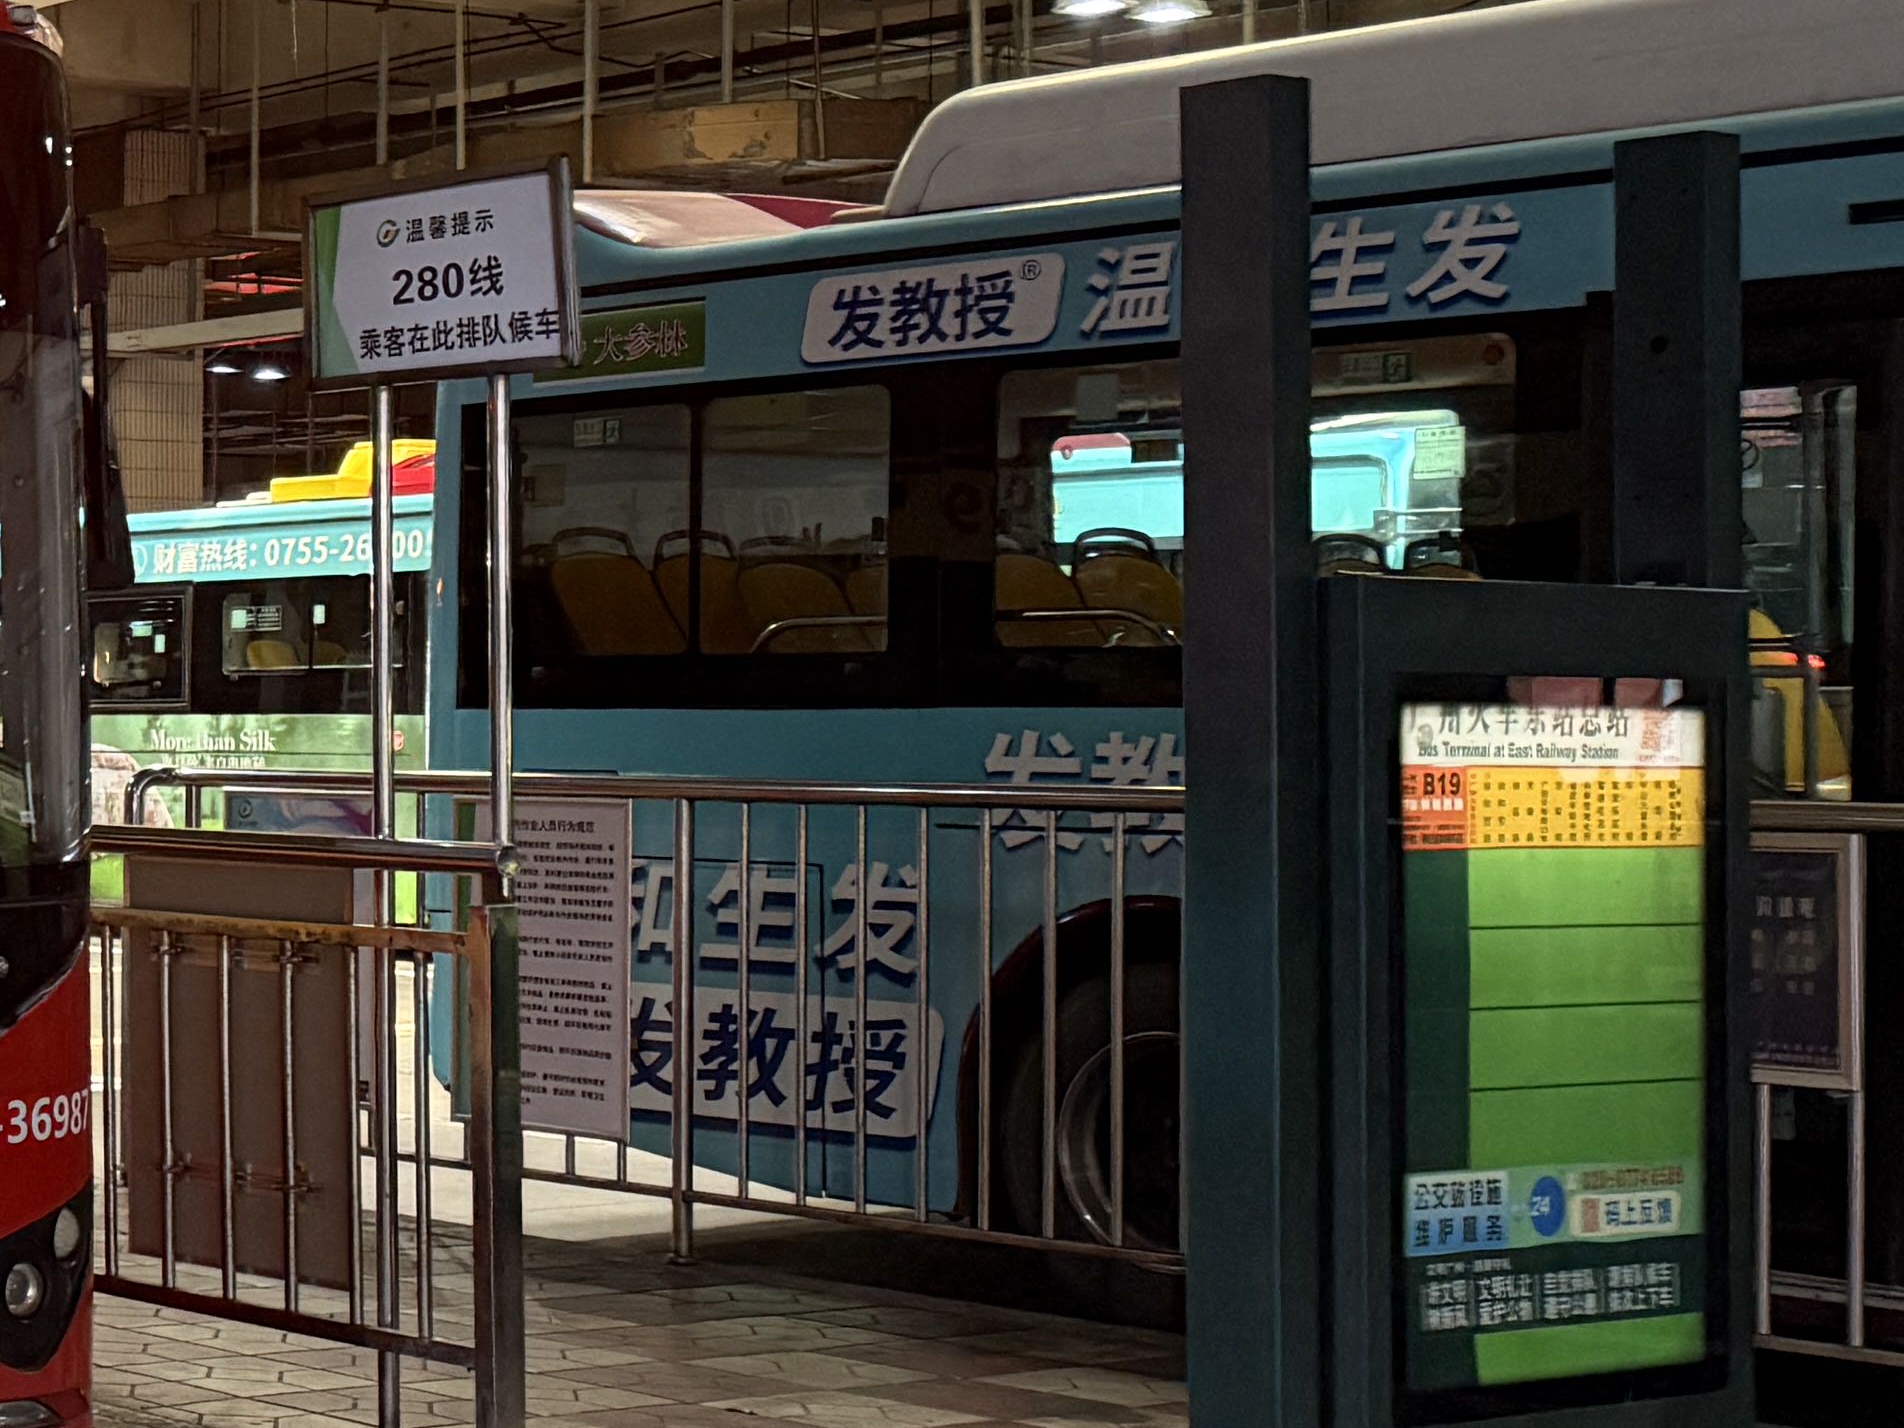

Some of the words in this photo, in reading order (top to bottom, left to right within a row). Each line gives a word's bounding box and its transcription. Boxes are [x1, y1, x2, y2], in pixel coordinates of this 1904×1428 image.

[406, 209, 494, 243] 温馨提示
[392, 255, 504, 305] 280线
[1080, 204, 1522, 339] 温生发
[827, 269, 1016, 352] 发教授
[359, 308, 560, 360] 乘客在此排队候车
[239, 729, 277, 751] Silk
[1418, 742, 1438, 757] Bus
[1444, 741, 1491, 758] Terminal
[1494, 745, 1505, 757] at
[1508, 742, 1533, 757] East
[1537, 742, 1578, 762] Railway
[1582, 743, 1619, 759] Station
[1423, 772, 1462, 796] B19
